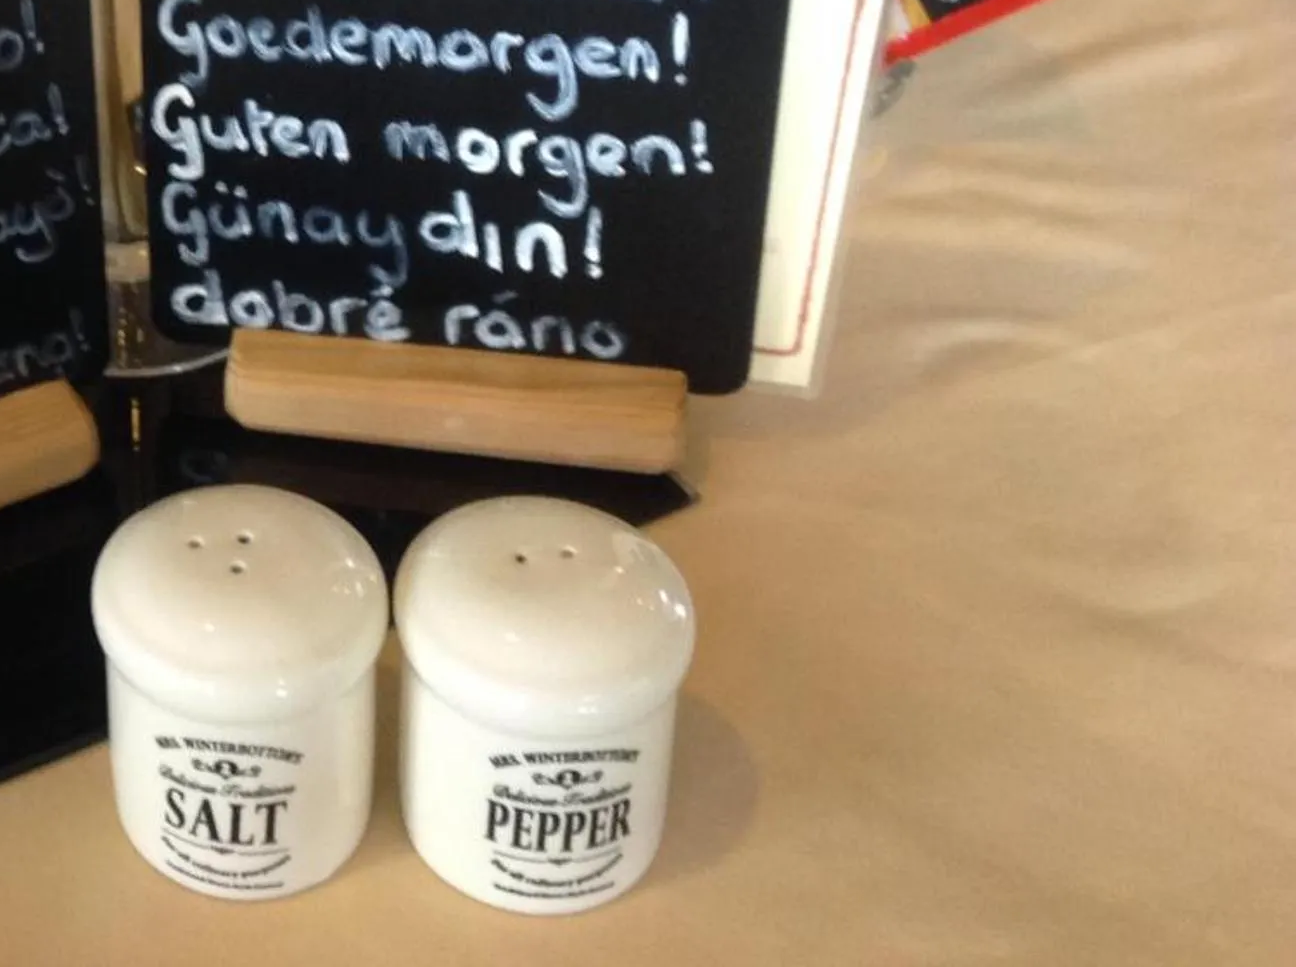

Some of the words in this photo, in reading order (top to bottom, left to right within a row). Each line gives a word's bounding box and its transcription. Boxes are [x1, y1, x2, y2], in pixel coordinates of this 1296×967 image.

[151, 83, 351, 181] Guten
[386, 118, 714, 219] morgen!
[164, 788, 288, 846] SALT
[483, 798, 633, 853] PEPPER
